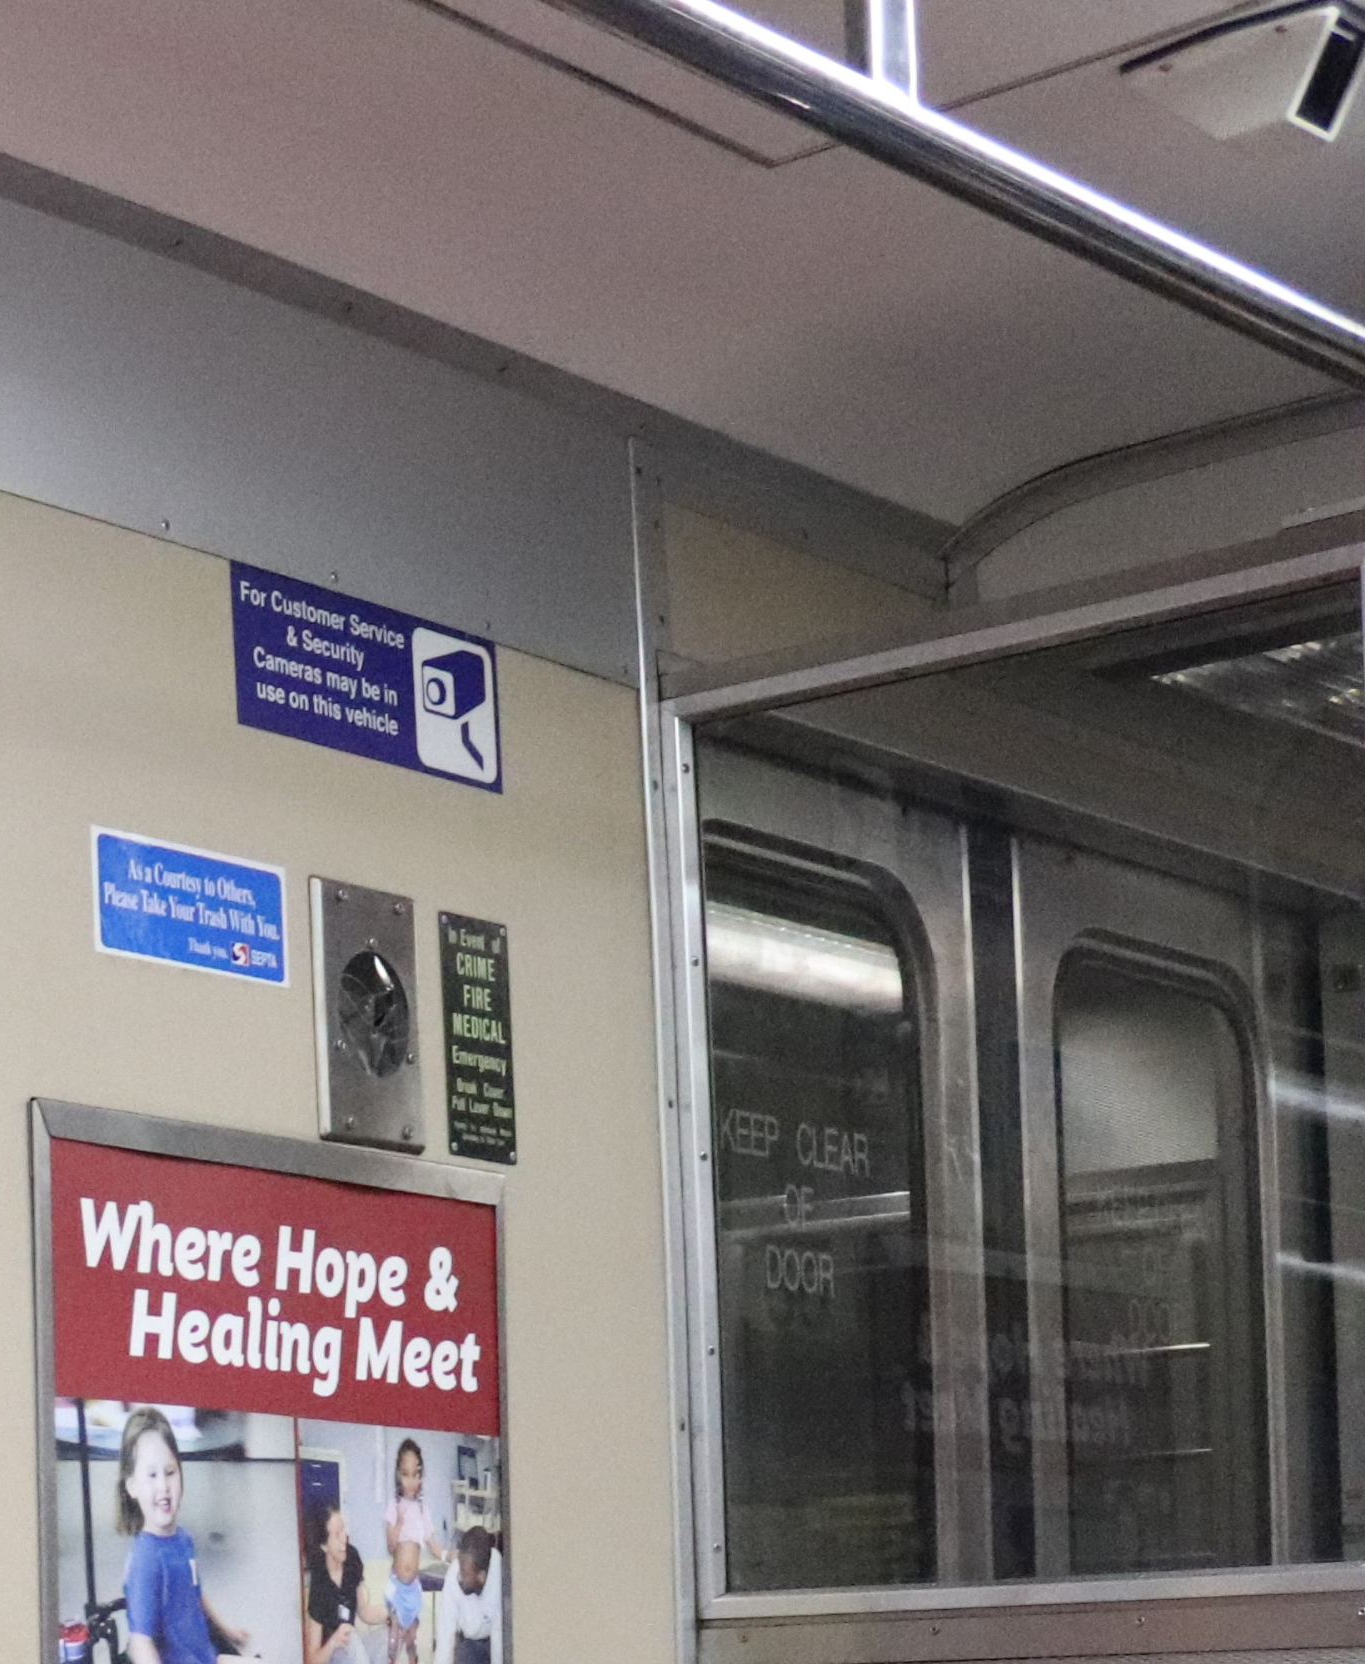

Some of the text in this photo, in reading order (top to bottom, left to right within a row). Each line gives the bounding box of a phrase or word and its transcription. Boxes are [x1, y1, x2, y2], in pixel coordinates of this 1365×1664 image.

[240, 581, 406, 650] For Customer Service
[287, 626, 365, 672] & Security
[254, 647, 399, 706] Cameras may be in
[257, 682, 399, 736] use on this vehicle
[128, 859, 257, 908] As a Courtesy to Others,
[104, 882, 281, 940] Please Take Your Trash With You.
[251, 950, 278, 968] SEPTA
[460, 929, 486, 951] Event
[456, 952, 496, 982] CRIME
[464, 985, 492, 1011] FIRE
[453, 1012, 507, 1044] MEDICAL
[452, 1045, 507, 1076] Emergency
[721, 1108, 870, 1177] KEEP CLEAR
[783, 1184, 815, 1232] OF
[80, 1196, 460, 1319] Where Hope &
[765, 1244, 836, 1298] DOOR
[129, 1288, 482, 1398] Healing Meet
